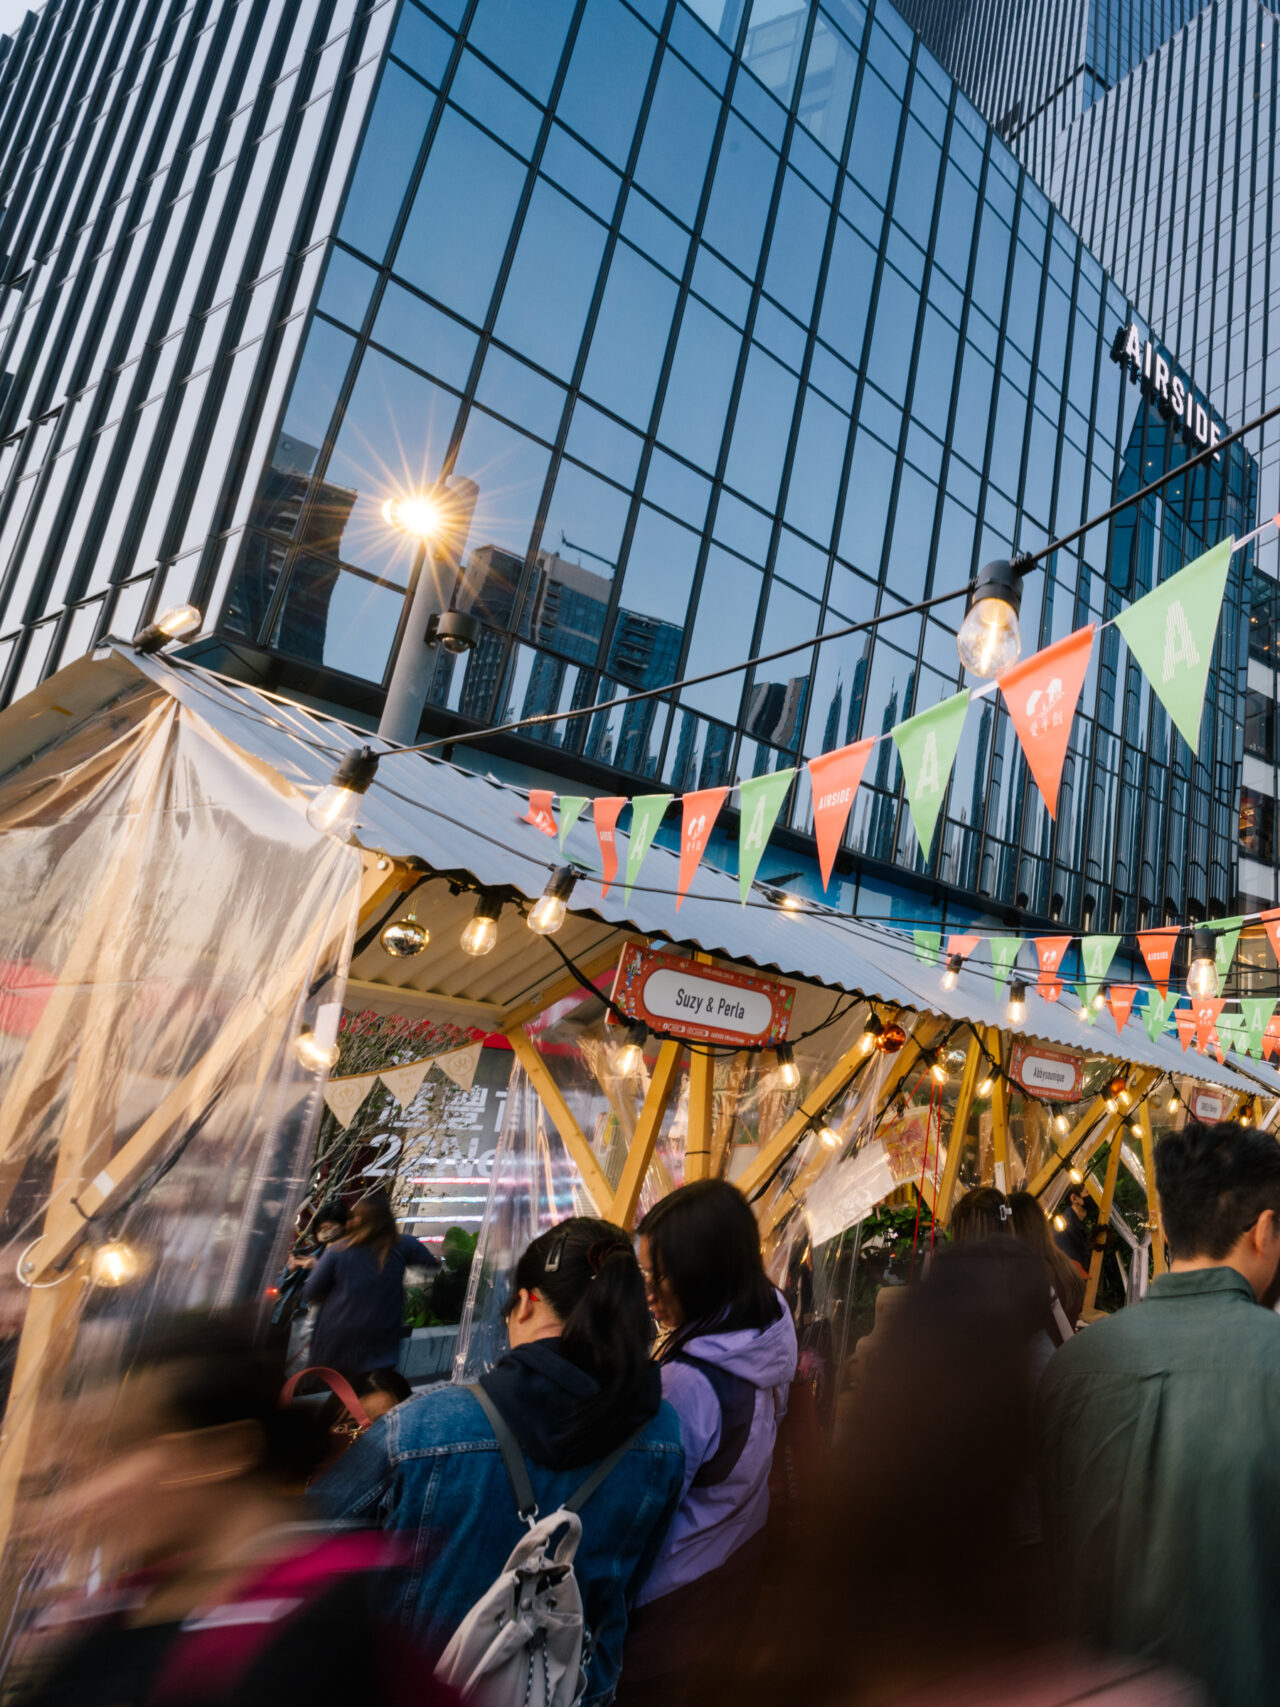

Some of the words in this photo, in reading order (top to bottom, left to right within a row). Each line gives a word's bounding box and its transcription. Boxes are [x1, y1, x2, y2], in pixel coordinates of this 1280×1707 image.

[1124, 323, 1222, 462] AIRSIDE
[1162, 599, 1200, 683] A
[915, 731, 939, 800] A
[818, 788, 851, 812] AIRSIDE
[630, 812, 649, 860] A
[744, 794, 766, 850] A
[996, 947, 1007, 975] A
[1089, 944, 1104, 975] A
[1147, 951, 1169, 961] AIRSIDE
[675, 987, 703, 1014] Suzy
[706, 997, 714, 1013] &
[717, 1001, 745, 1020] Perla
[1153, 999, 1164, 1022] A
[1221, 1020, 1232, 1040] A
[1251, 1007, 1263, 1032] A
